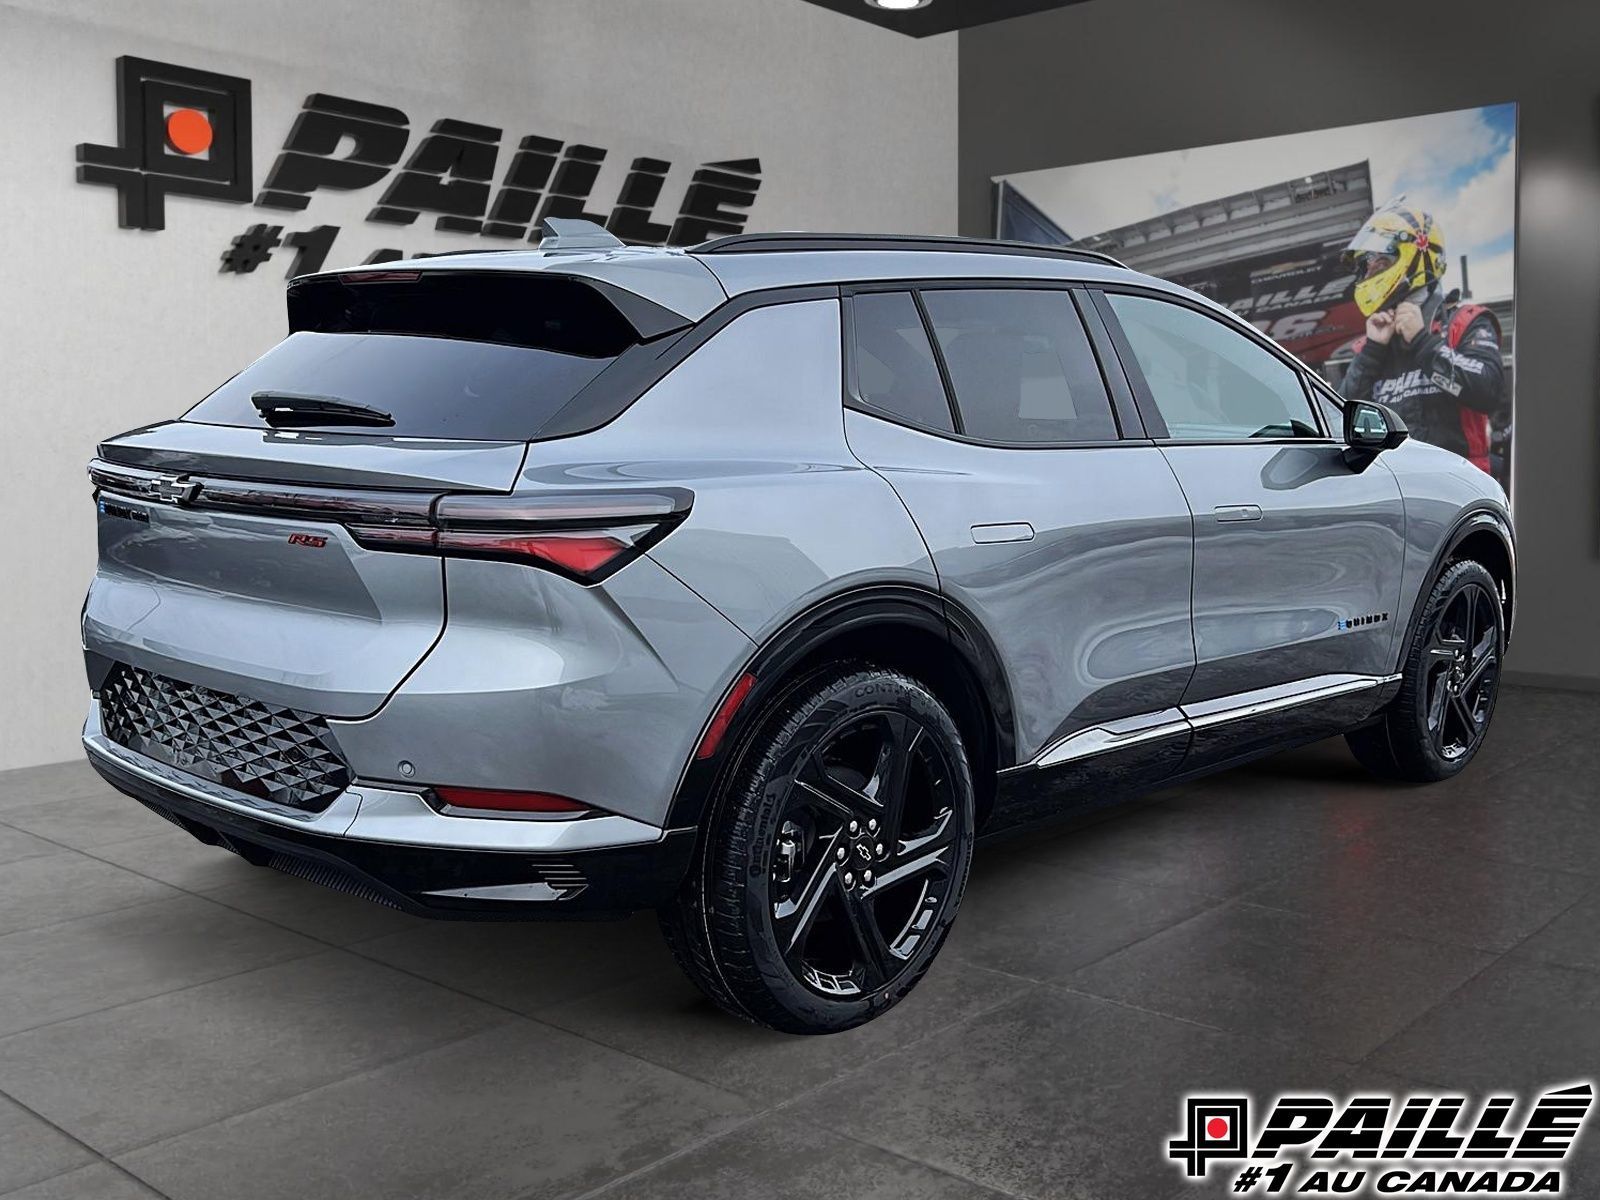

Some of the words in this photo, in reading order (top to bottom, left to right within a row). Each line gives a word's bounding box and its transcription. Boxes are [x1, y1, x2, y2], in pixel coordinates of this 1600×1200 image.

[253, 92, 762, 246] PAILLÉ
[219, 223, 341, 280] #1
[288, 533, 328, 548] RS
